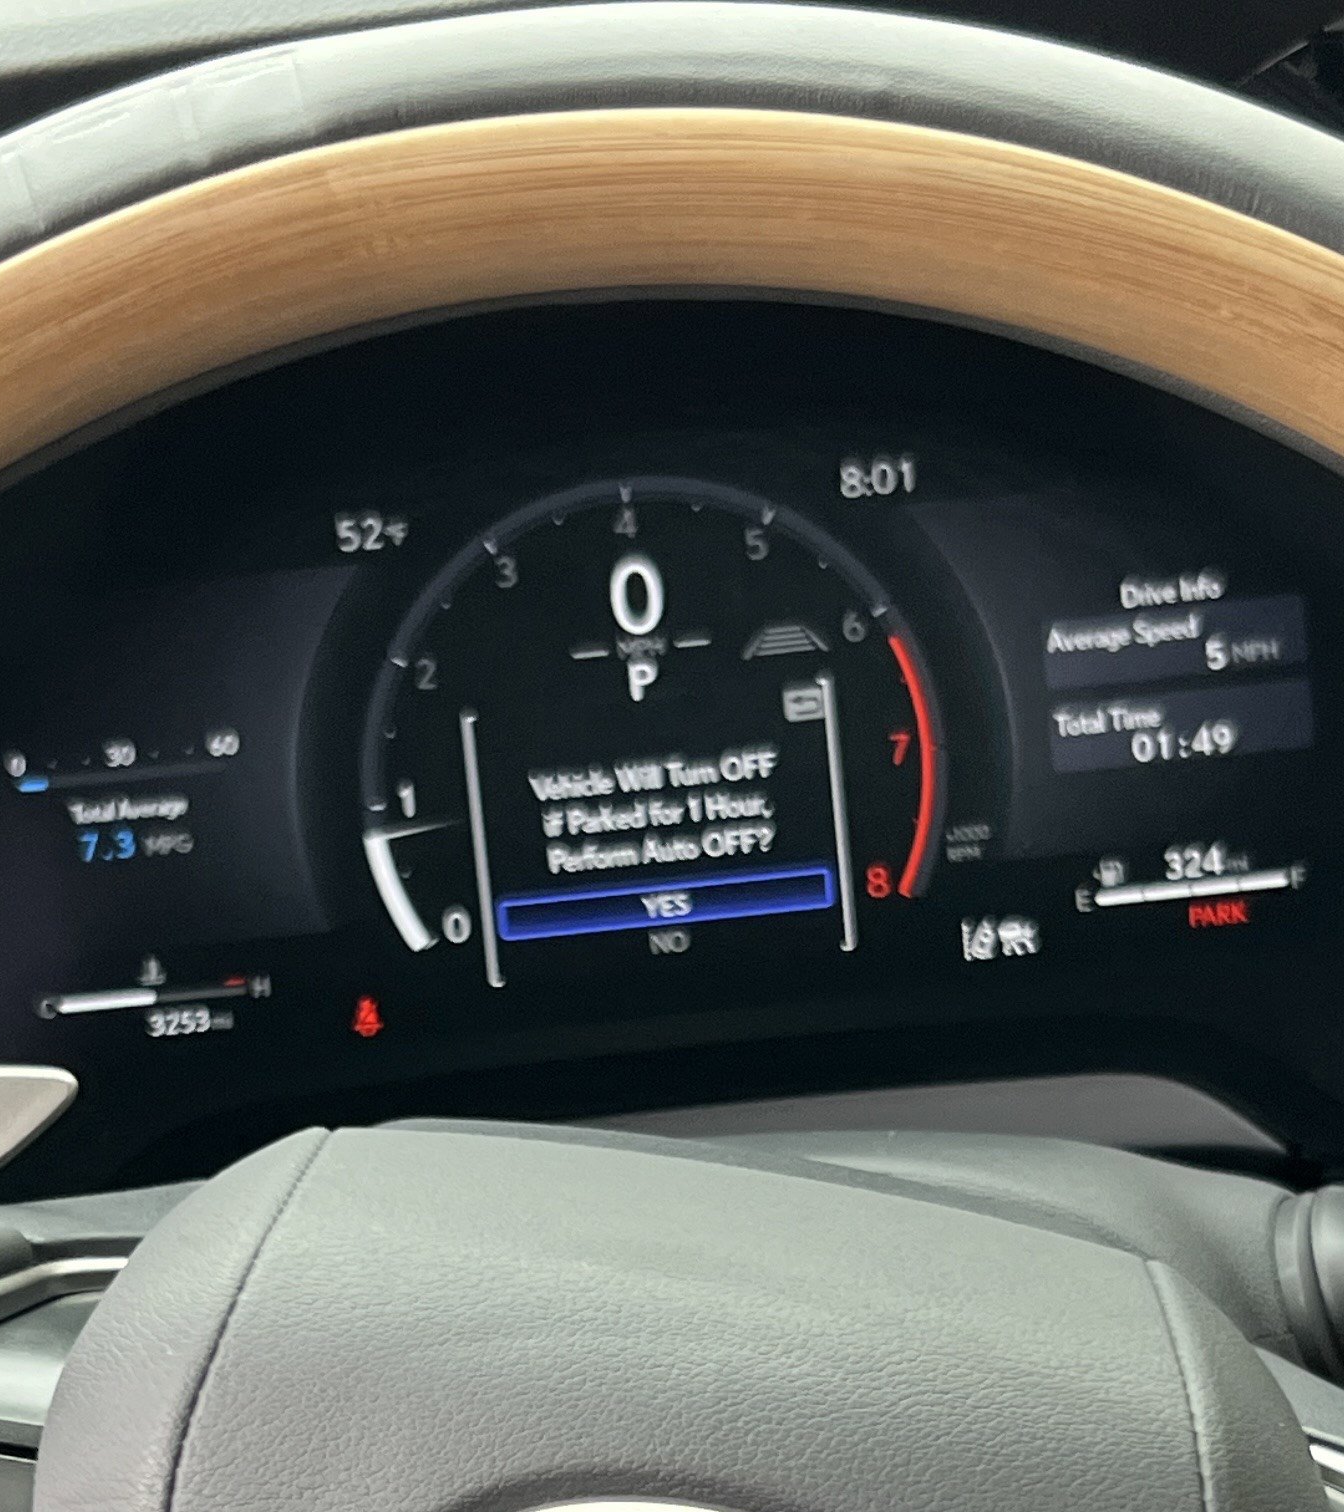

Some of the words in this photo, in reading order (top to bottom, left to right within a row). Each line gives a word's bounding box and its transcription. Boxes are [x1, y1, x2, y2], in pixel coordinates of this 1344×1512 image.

[840, 456, 916, 498] 8:01
[614, 507, 637, 538] 4
[745, 526, 769, 561] 5
[495, 556, 519, 588] 3
[610, 553, 664, 636] 0
[1120, 577, 1178, 609] Drive
[842, 612, 866, 643] 6
[1047, 623, 1132, 654] Average
[1132, 611, 1202, 647] Speed
[1205, 633, 1229, 671] 5
[415, 655, 438, 690] 2
[628, 660, 657, 702] P
[1053, 706, 1106, 738] Total
[1107, 701, 1163, 732] Time
[889, 731, 911, 766] 7
[1130, 718, 1239, 763] 01:49
[528, 768, 615, 802] Vehicle
[663, 756, 720, 788] Turn
[719, 744, 777, 782] OFF
[398, 780, 417, 819] 1
[565, 800, 649, 836] Parked
[79, 829, 137, 863] 7.3
[546, 840, 642, 875] Perform
[641, 832, 703, 865] Auto
[702, 822, 777, 858] OFF?
[1163, 841, 1225, 881] 324
[866, 864, 892, 899] 8
[1074, 885, 1093, 913] E
[641, 891, 693, 920] YES
[1188, 900, 1250, 928] PARK
[441, 905, 472, 944] 0
[648, 926, 692, 955] NO
[145, 1005, 211, 1037] 3253
